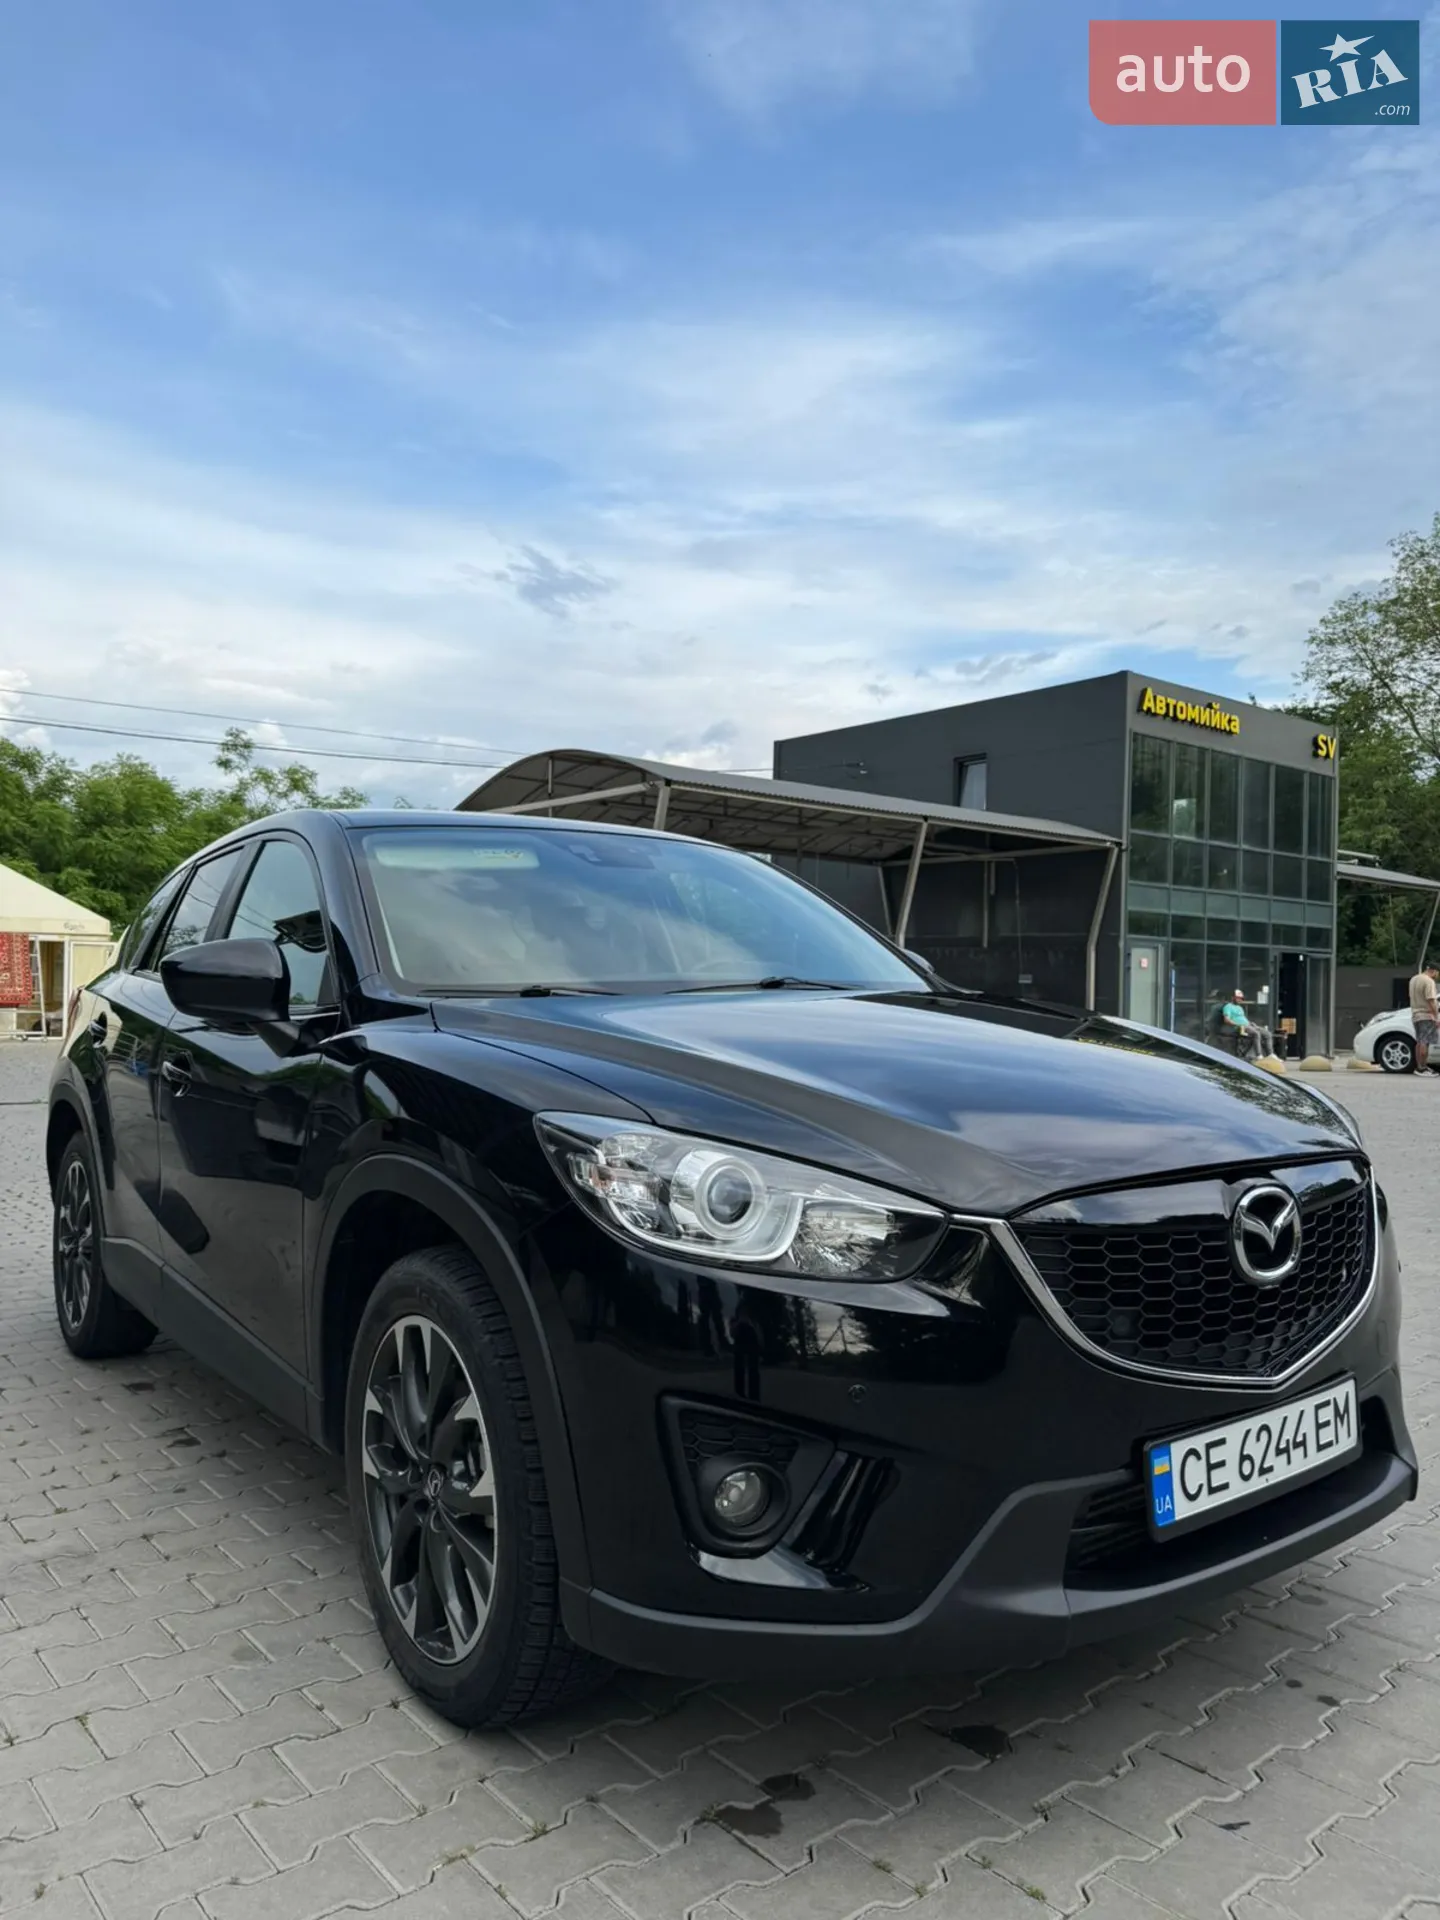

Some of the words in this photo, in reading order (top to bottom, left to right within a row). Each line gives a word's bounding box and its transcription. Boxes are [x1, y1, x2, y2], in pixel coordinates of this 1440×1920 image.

[1143, 687, 1240, 735] Автомийка
[1317, 734, 1337, 760] SV
[1179, 1437, 1230, 1502] CE
[1238, 1409, 1308, 1483] 6244
[1314, 1391, 1352, 1453] EM
[1155, 1494, 1173, 1514] UA
